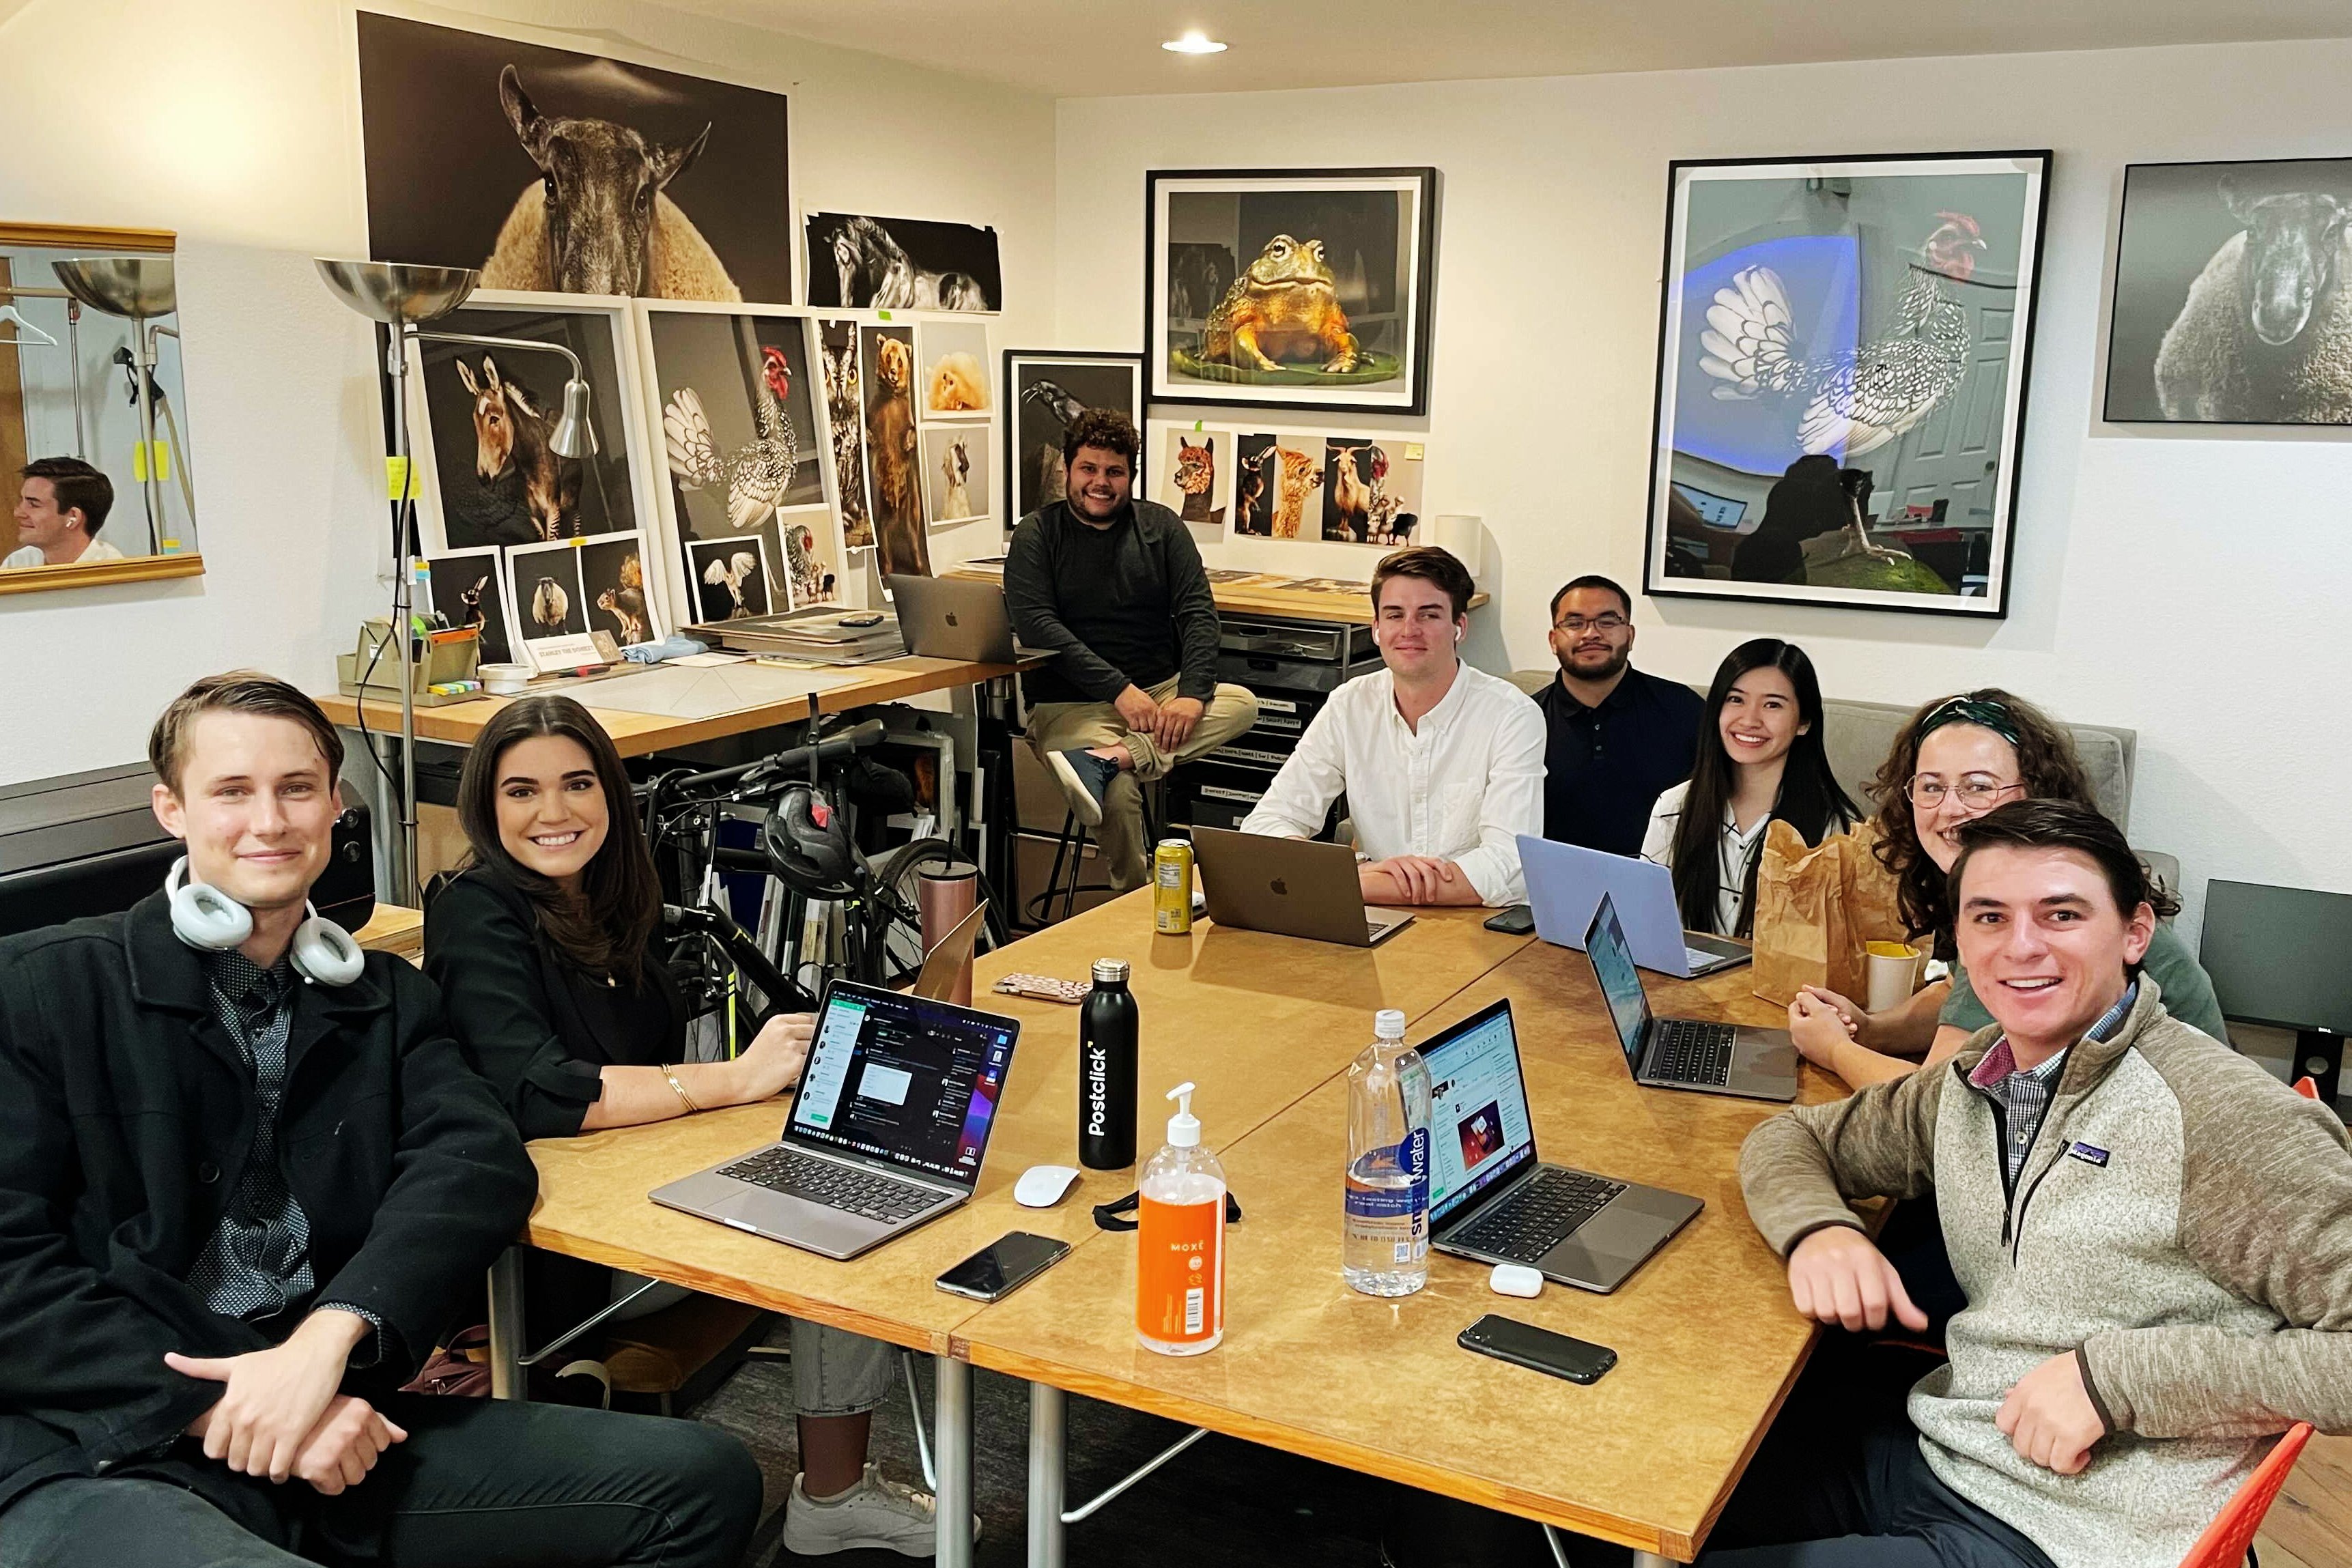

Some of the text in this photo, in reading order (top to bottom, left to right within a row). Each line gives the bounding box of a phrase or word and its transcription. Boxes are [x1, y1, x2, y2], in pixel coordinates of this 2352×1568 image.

[1088, 1047, 1106, 1137] Postclick
[1410, 1130, 1425, 1236] smtwater
[2071, 1150, 2101, 1164] tagonia
